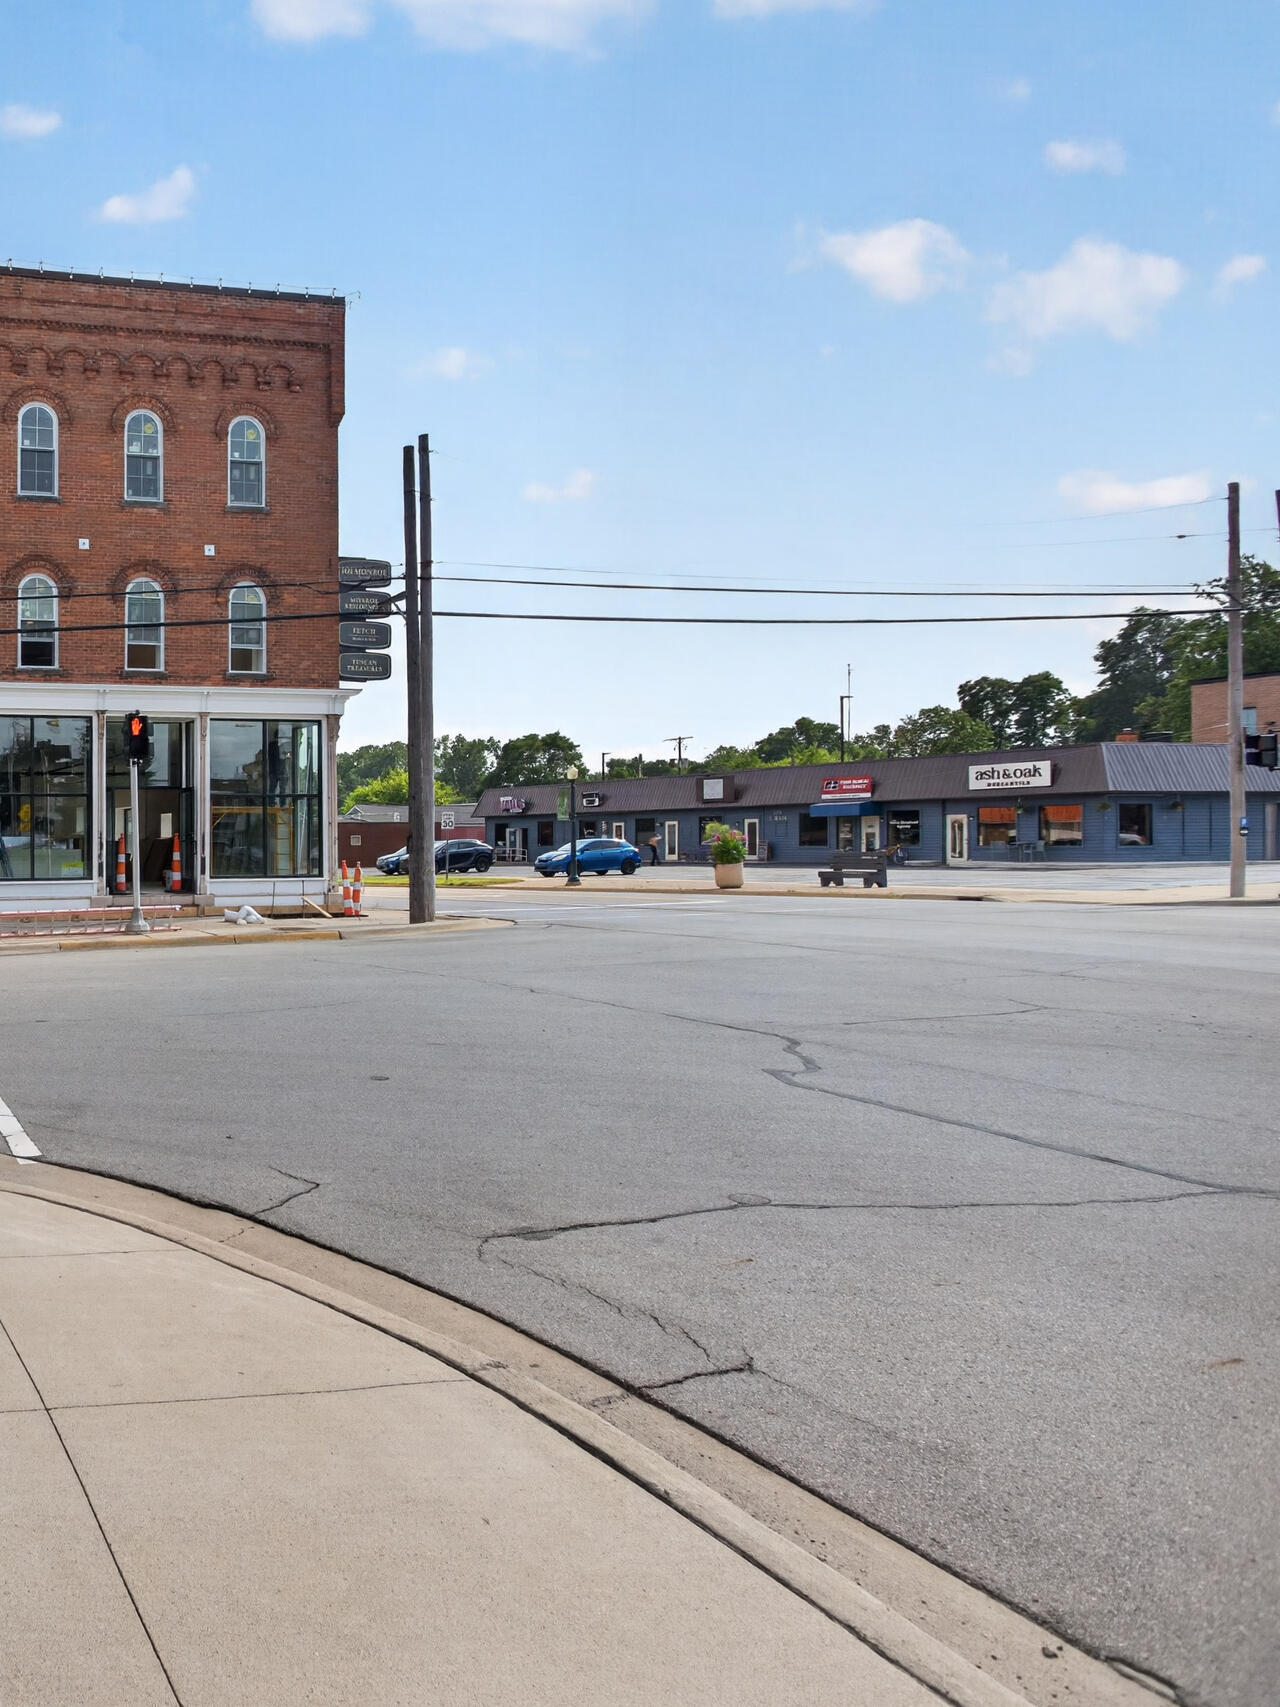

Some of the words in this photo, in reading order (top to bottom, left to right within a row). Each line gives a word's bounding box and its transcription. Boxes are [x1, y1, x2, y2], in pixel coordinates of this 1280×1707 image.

[975, 767, 1000, 781] ash
[1002, 768, 1012, 779] &
[1013, 764, 1042, 779] oak
[442, 820, 454, 828] 30
